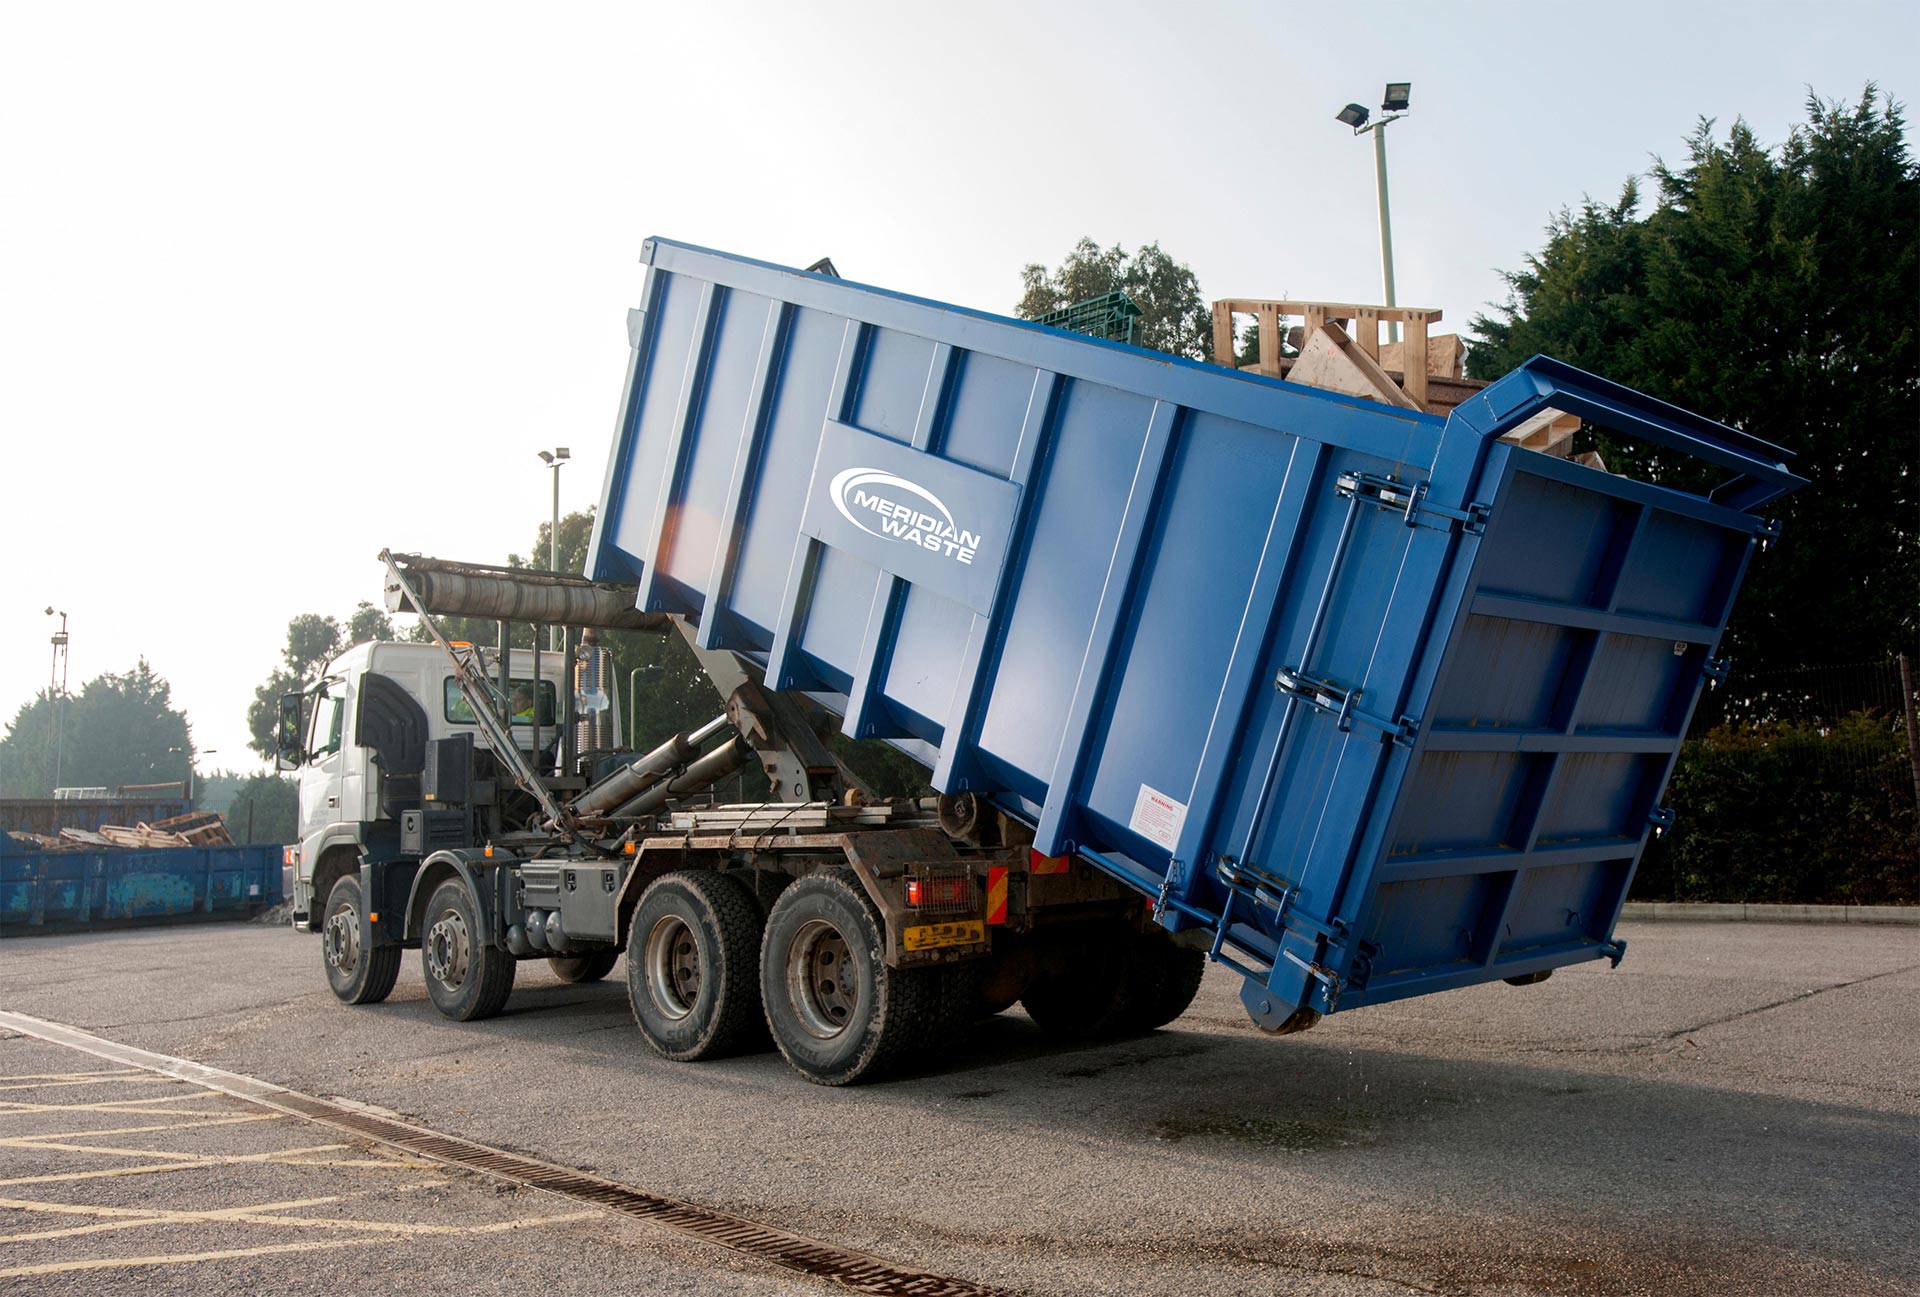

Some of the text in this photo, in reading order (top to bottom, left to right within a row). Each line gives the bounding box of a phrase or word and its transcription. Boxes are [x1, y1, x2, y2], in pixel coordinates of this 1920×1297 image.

[853, 489, 981, 550] MERIDIAN
[881, 516, 976, 565] WASTE
[1151, 796, 1174, 811] WARNING
